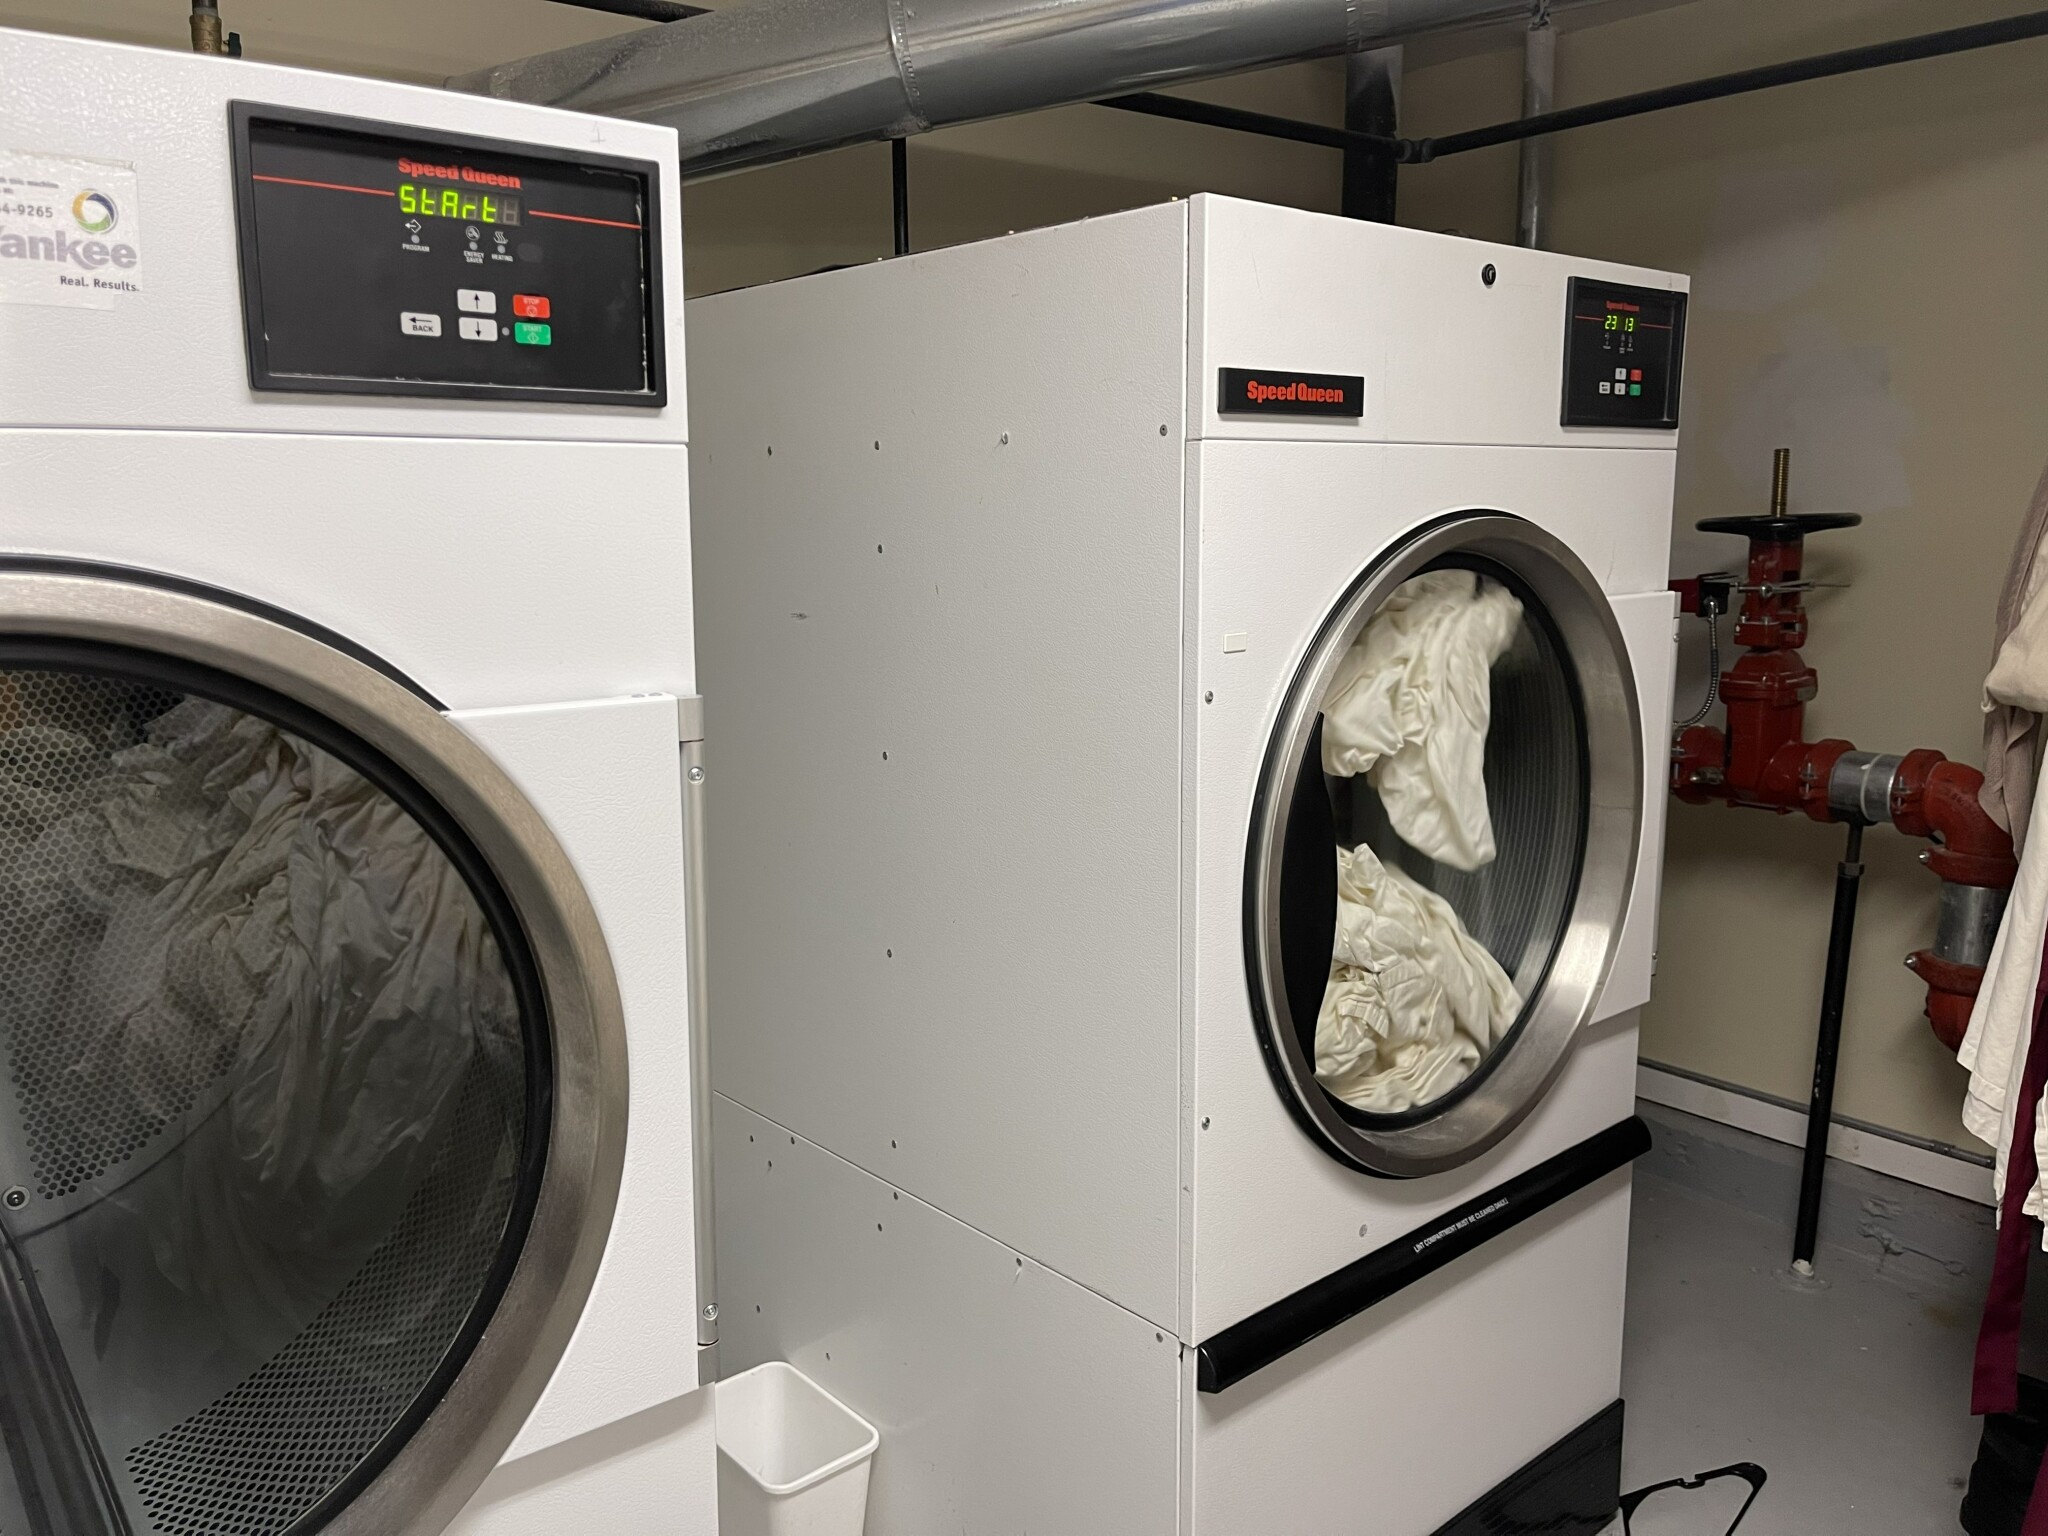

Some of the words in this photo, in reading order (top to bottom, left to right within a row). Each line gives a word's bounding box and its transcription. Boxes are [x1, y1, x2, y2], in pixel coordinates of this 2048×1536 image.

[398, 157, 459, 179] Speed
[461, 165, 521, 189] Queen
[0, 202, 54, 218] 4-9265
[0, 226, 137, 270] ankee
[402, 243, 430, 252] PROGRAM
[463, 250, 485, 259] ENERGY
[466, 256, 484, 264] SAVER
[491, 253, 514, 262] HEATING
[60, 275, 89, 287] Real.
[93, 278, 140, 292] Results.
[523, 297, 540, 305] STOP
[412, 324, 434, 333] BACK
[522, 324, 542, 332] START
[1604, 315, 1617, 330] 23
[1624, 317, 1634, 332] 13
[1247, 380, 1297, 404] Speed
[1297, 382, 1344, 403] Queen
[1413, 1241, 1425, 1253] LINT
[1423, 1224, 1457, 1247] COMPARTMENT
[1455, 1217, 1470, 1230] MUST
[1474, 1204, 1496, 1220] CLEANED
